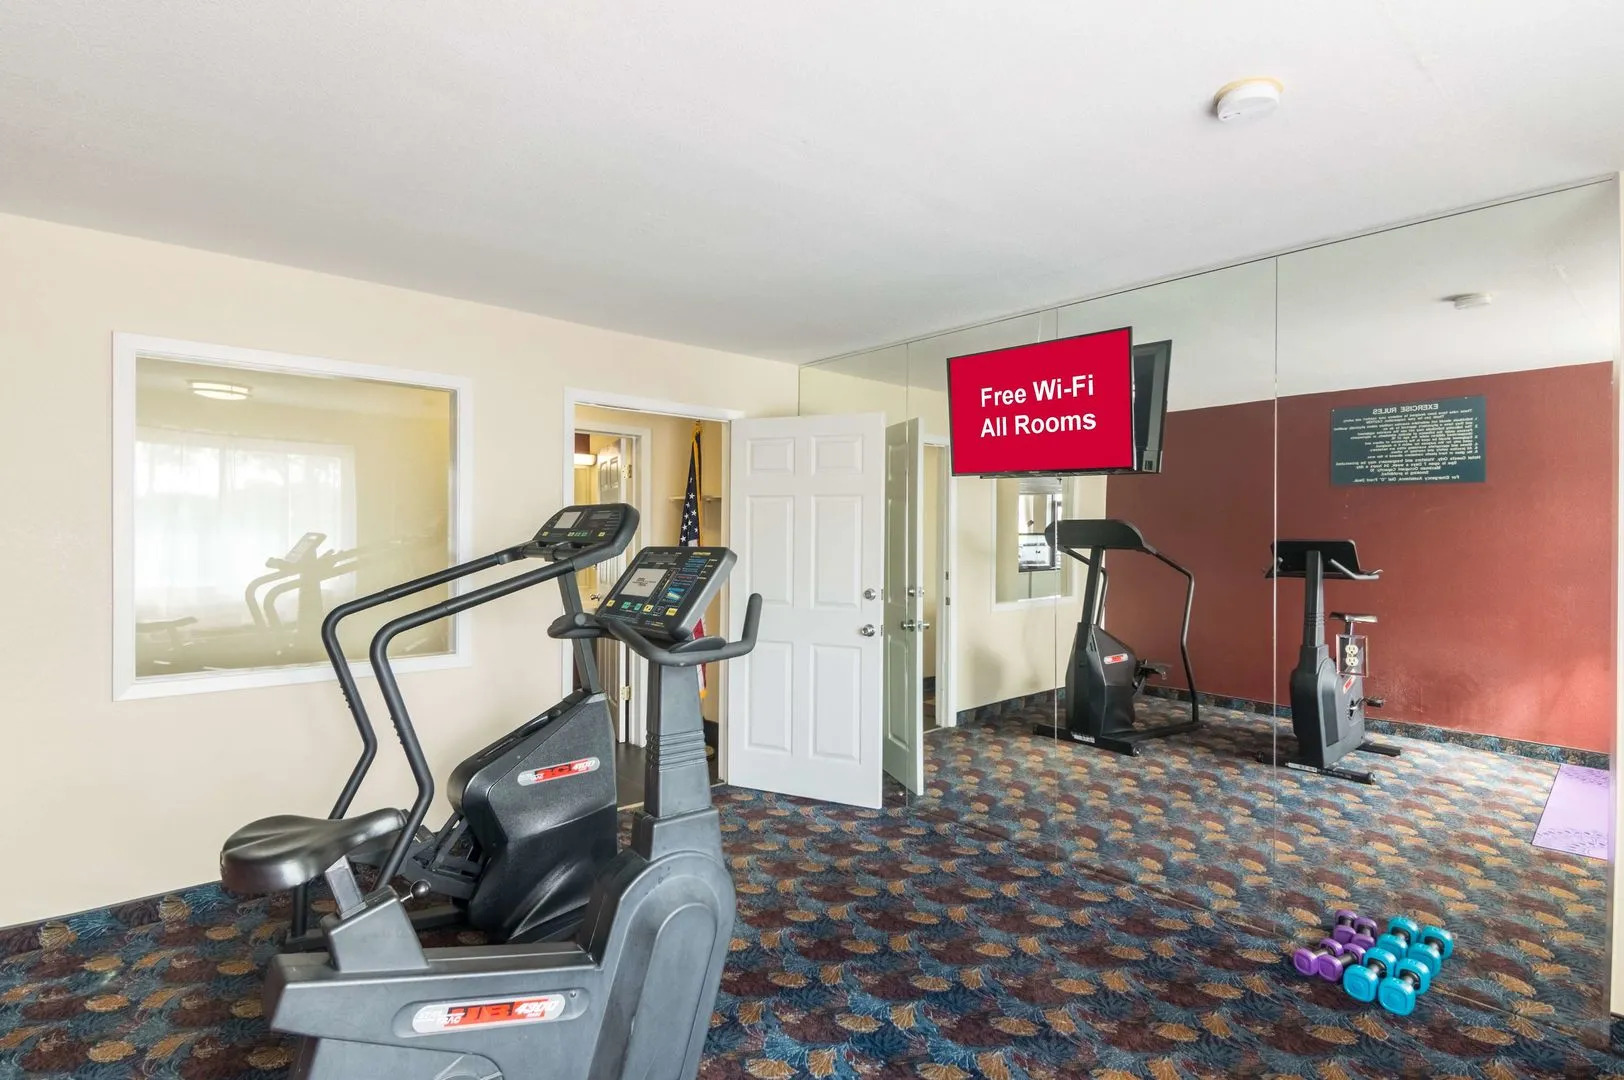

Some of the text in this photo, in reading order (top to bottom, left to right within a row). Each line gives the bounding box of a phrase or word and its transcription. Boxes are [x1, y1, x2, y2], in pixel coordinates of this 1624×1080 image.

[981, 374, 1094, 408] Free Wi-Fi
[981, 413, 1097, 438] All Rooms
